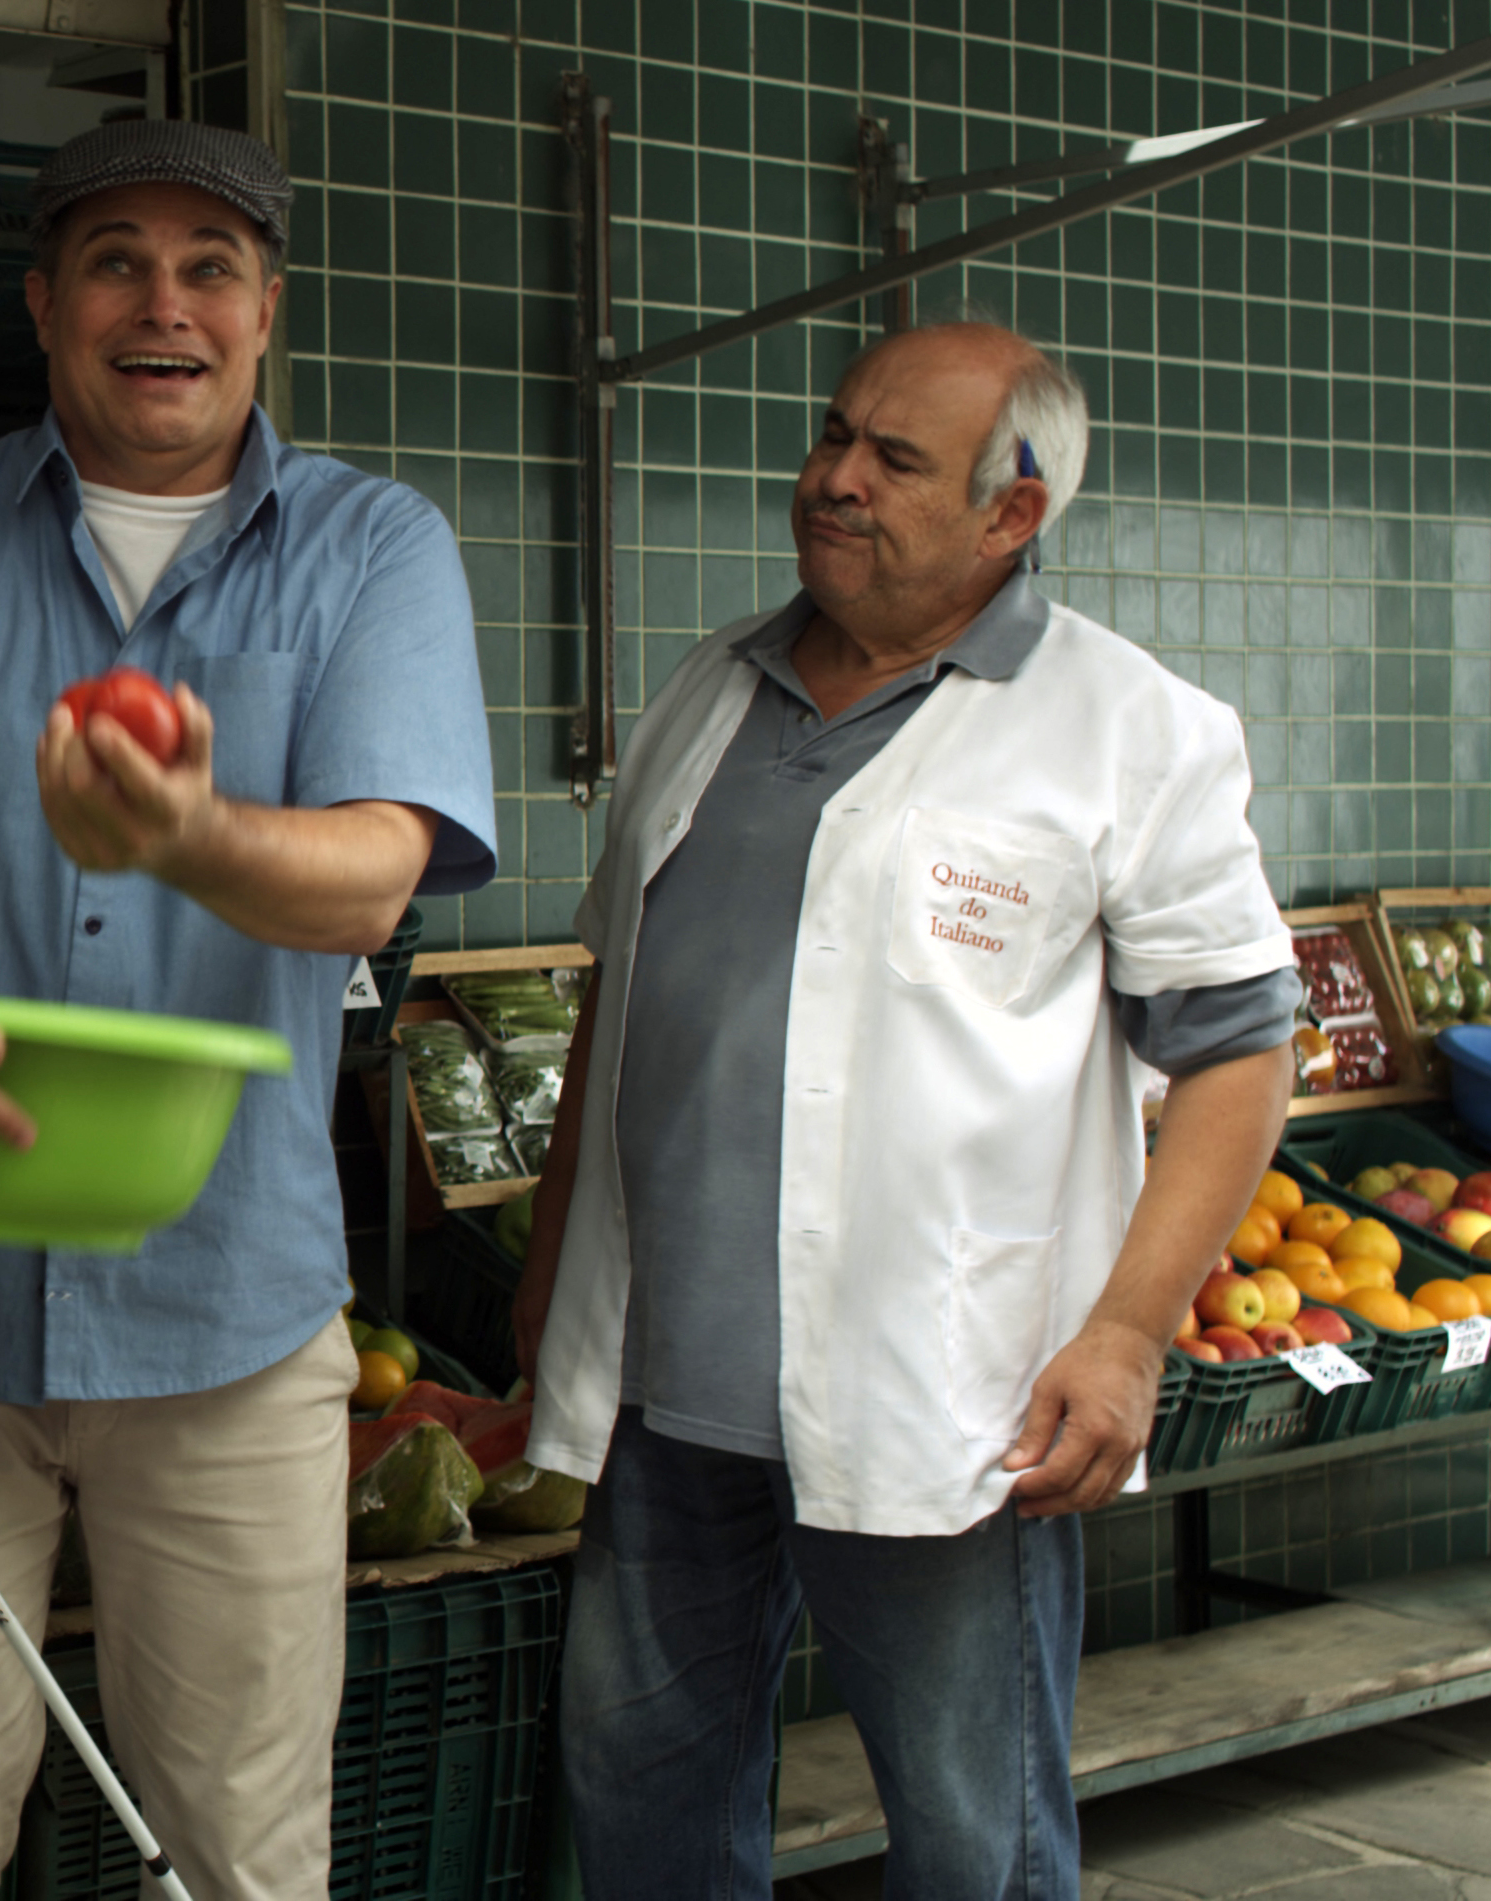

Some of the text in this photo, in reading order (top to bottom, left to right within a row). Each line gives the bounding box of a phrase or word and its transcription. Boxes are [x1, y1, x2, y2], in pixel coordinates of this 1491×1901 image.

[931, 862, 1029, 905] Quitanda
[959, 897, 987, 920] do
[930, 916, 1004, 953] Italiano
